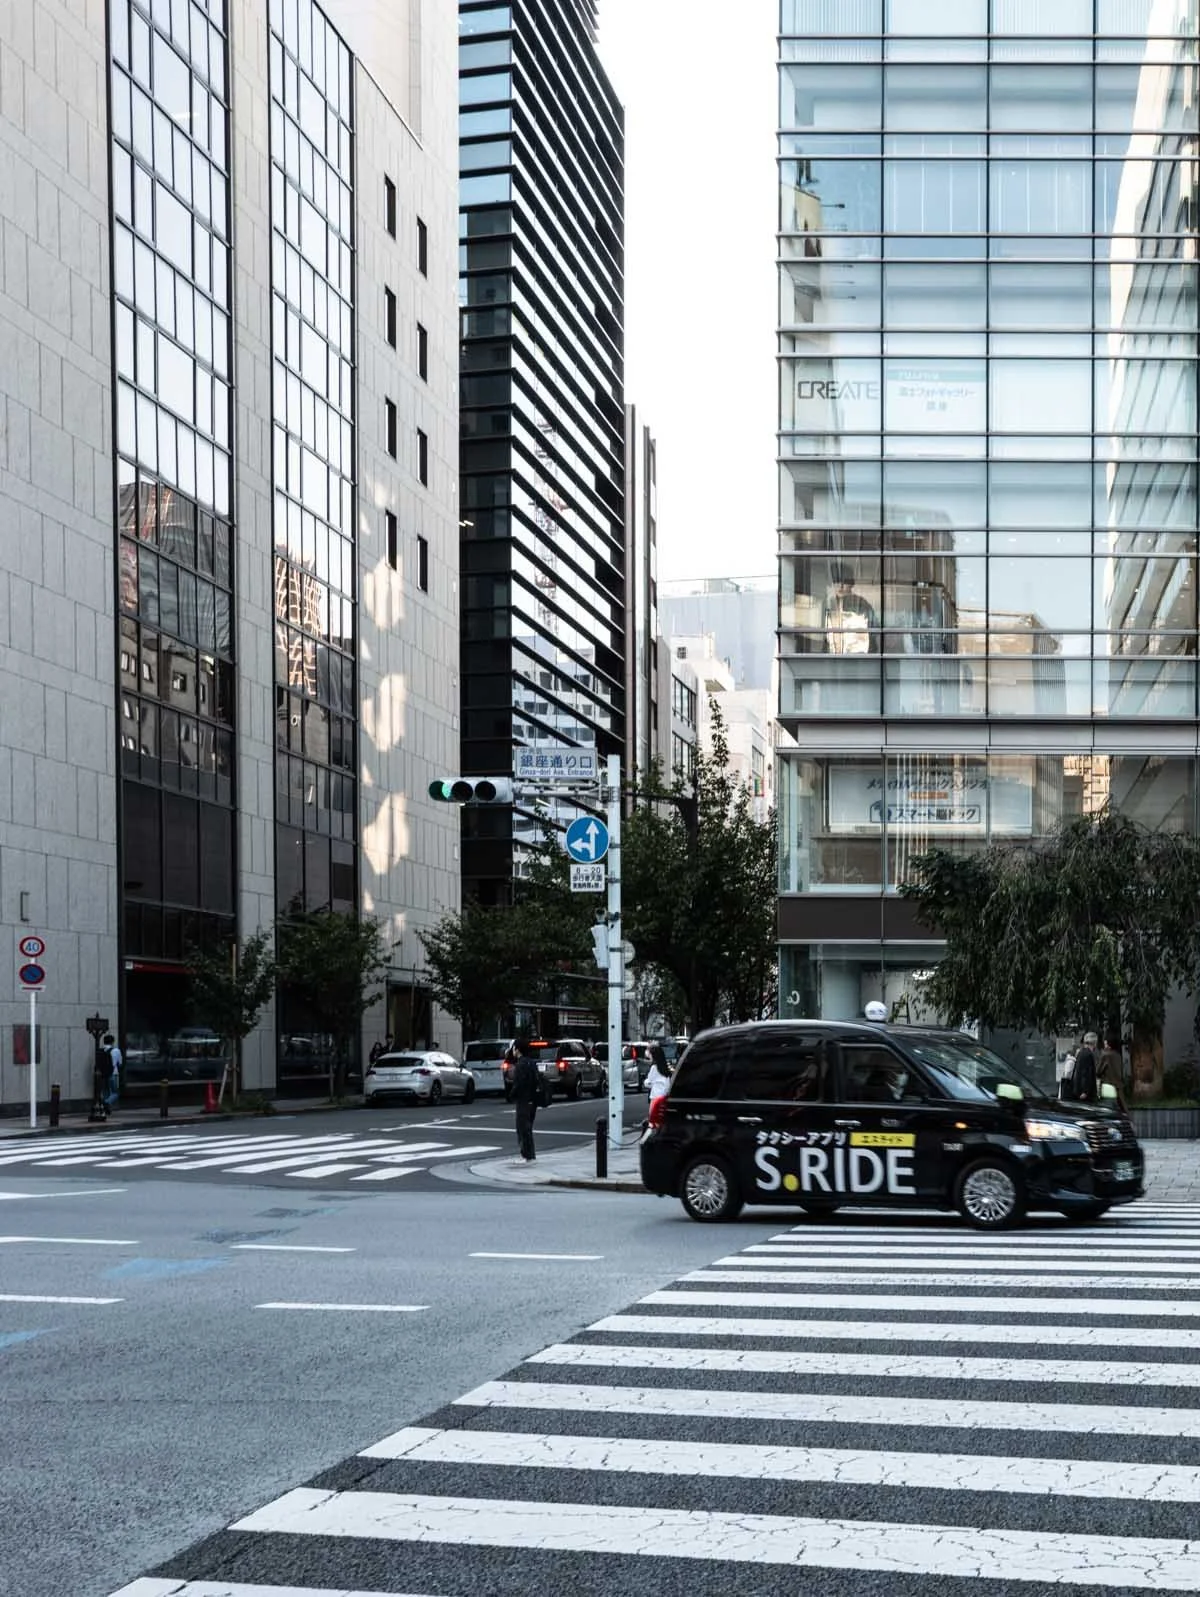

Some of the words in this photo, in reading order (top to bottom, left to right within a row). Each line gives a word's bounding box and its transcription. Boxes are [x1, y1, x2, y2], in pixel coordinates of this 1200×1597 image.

[797, 380, 880, 400] CREATE
[520, 754, 592, 769] 銀座通り口
[25, 942, 40, 953] 40
[756, 1131, 847, 1146] タクシーアプリ
